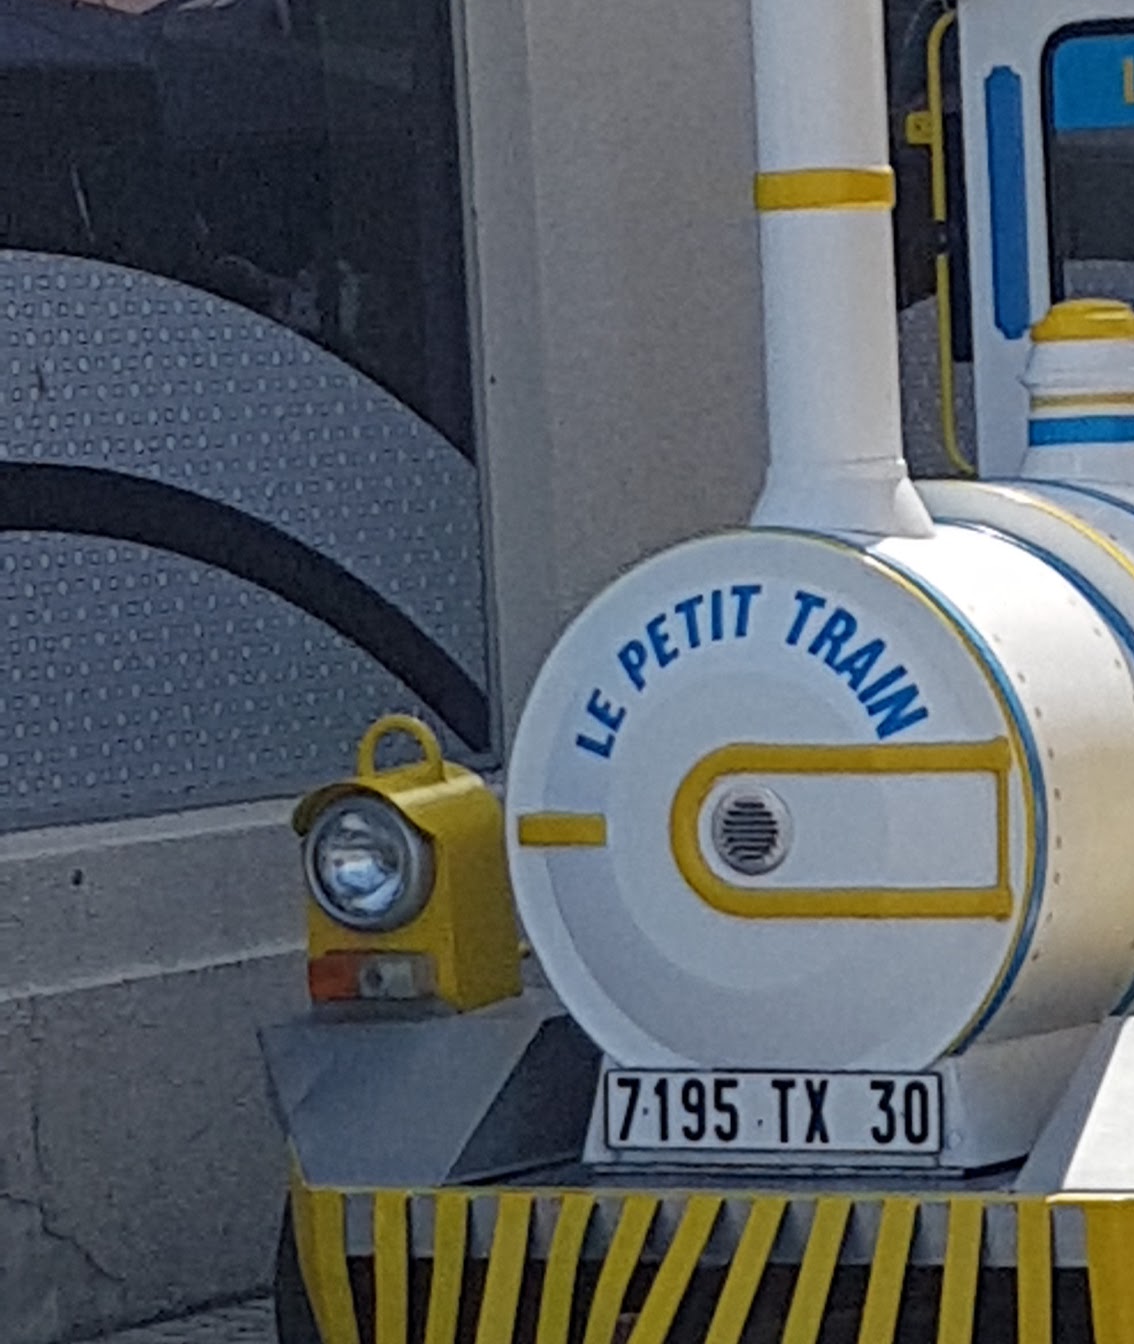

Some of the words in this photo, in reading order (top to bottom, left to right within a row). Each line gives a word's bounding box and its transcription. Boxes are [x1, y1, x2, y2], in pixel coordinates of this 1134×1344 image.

[575, 687, 627, 760] LE
[616, 583, 763, 694] PETIT
[783, 589, 932, 742] TRAIN
[616, 1077, 740, 1142] 7195
[770, 1079, 830, 1144] TX
[869, 1079, 930, 1145] 30
